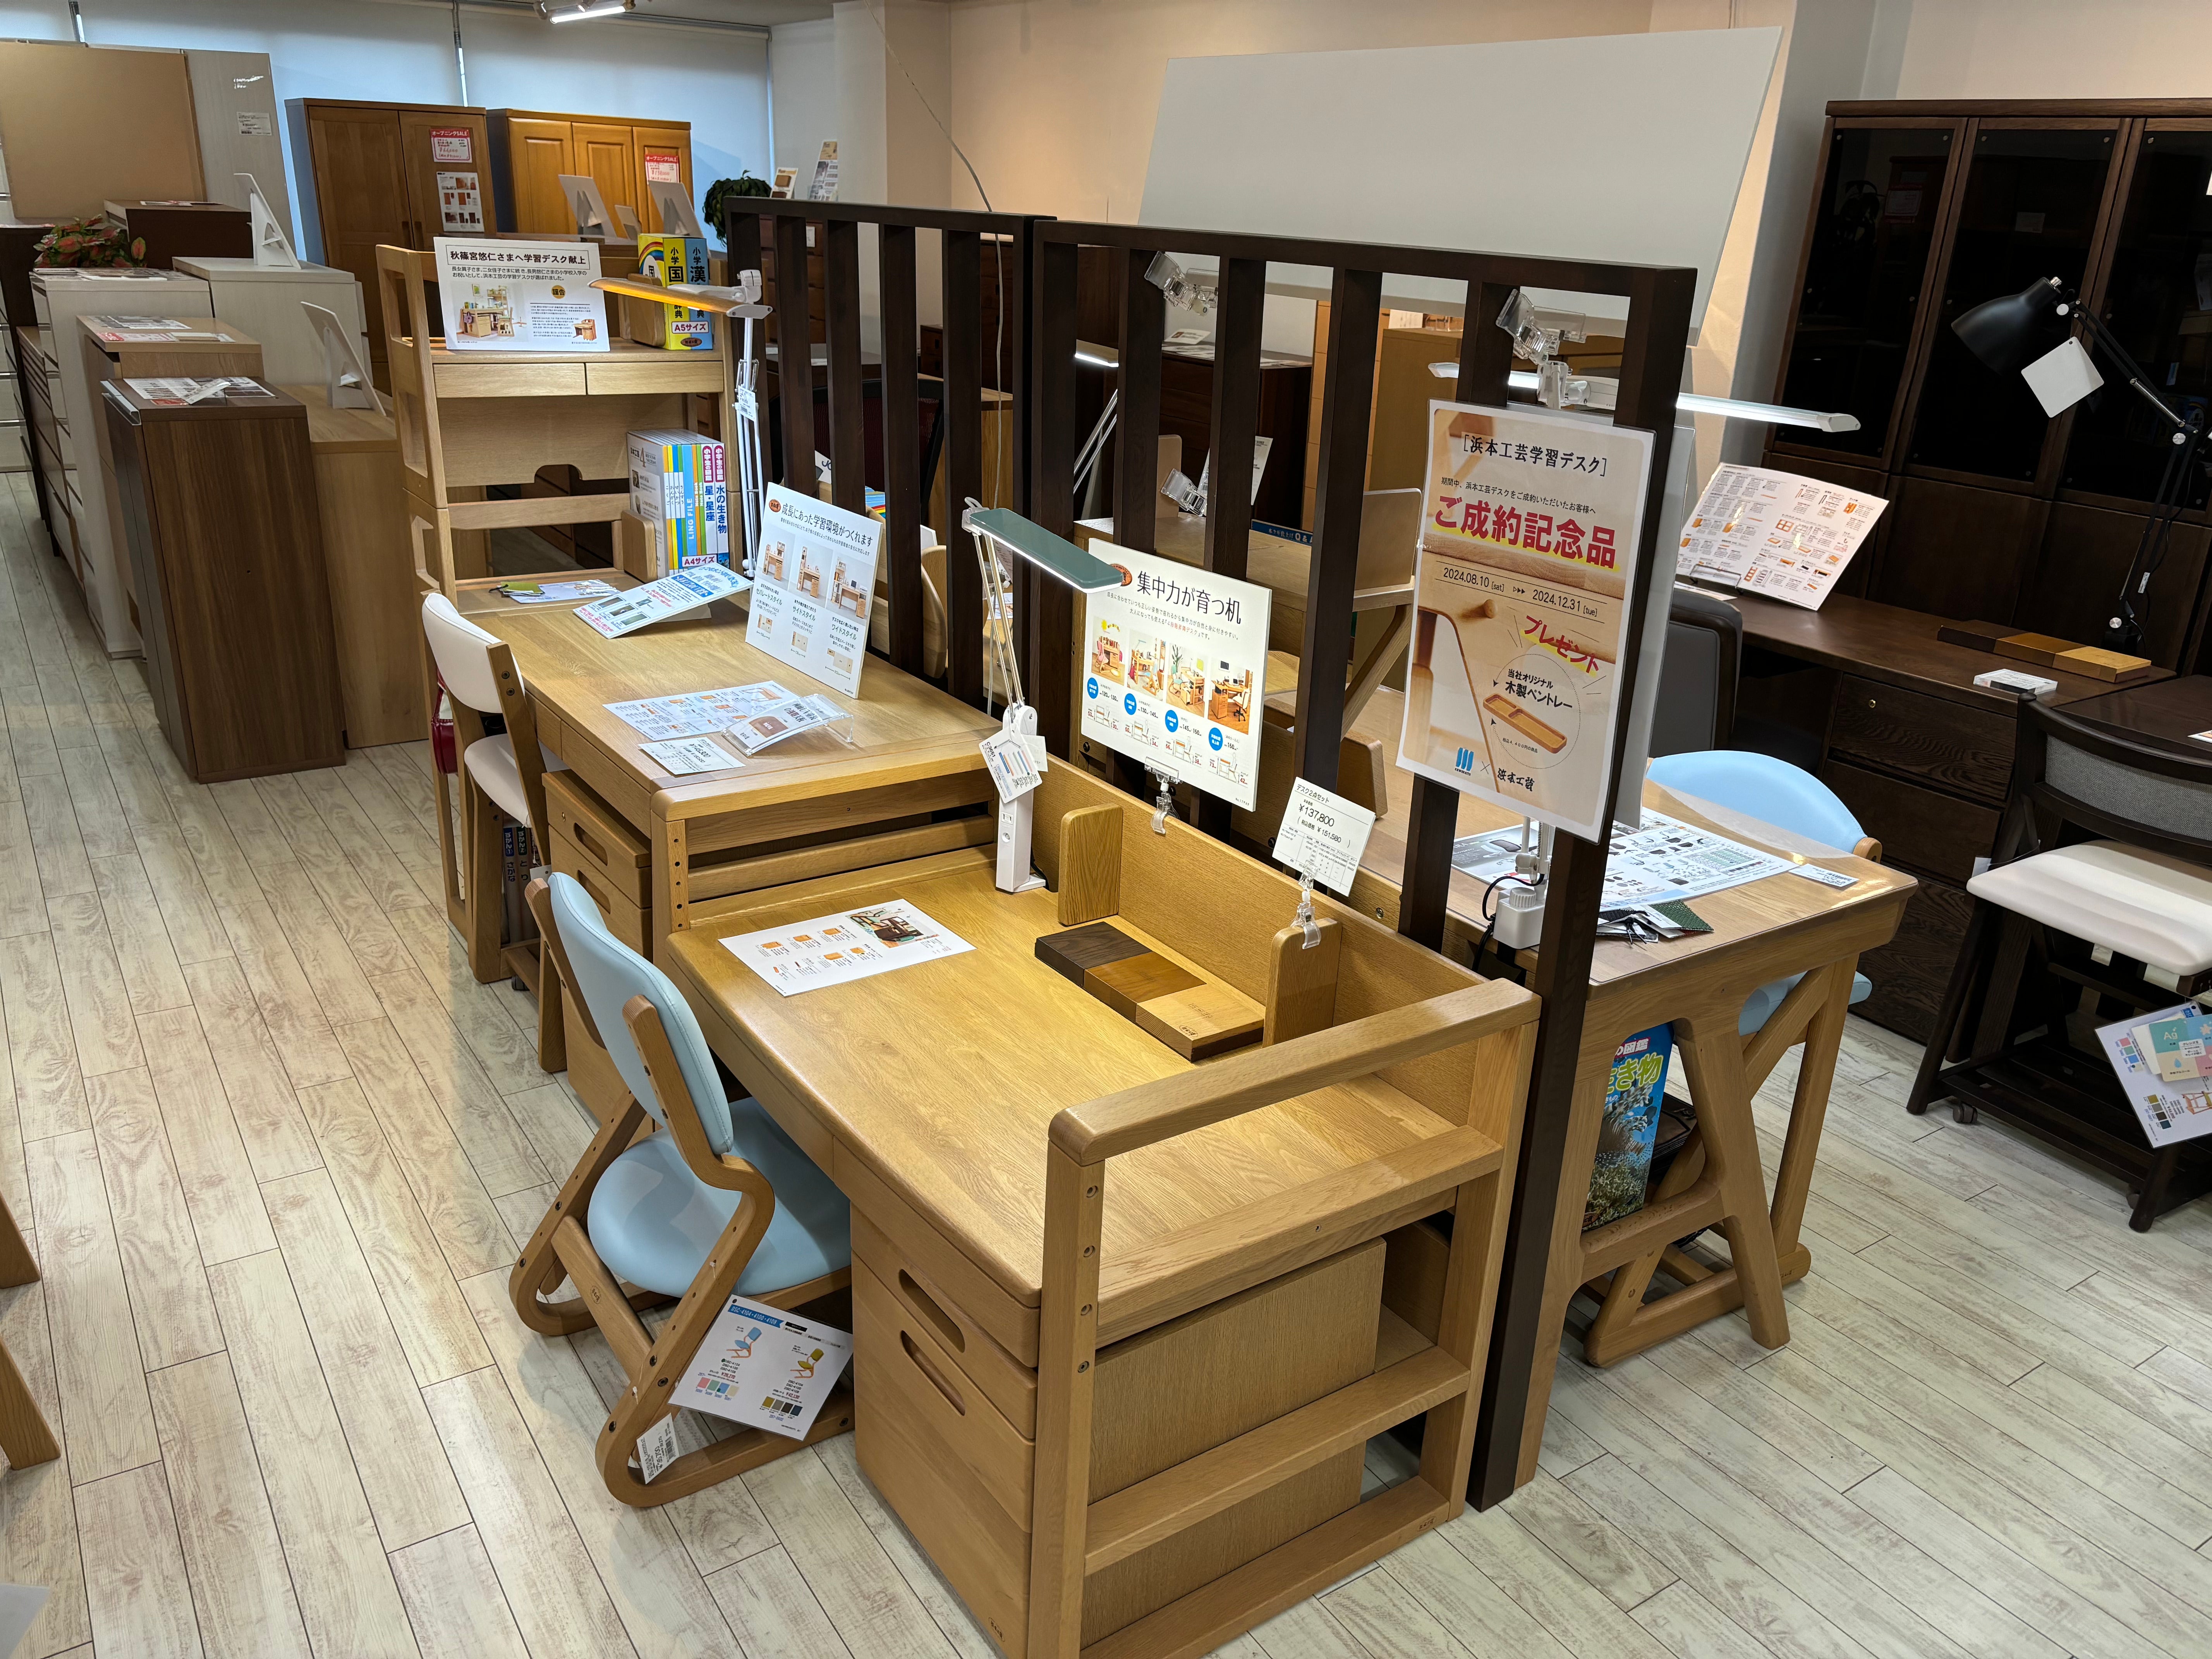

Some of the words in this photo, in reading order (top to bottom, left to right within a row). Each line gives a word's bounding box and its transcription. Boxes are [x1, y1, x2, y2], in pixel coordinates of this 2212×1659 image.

[450, 251, 586, 264] 秋篠宮悠仁さまへ学習デスク献上
[674, 323, 706, 331] A5サイズ
[703, 448, 713, 481] 小学生の
[715, 448, 724, 481] 小学生の
[705, 486, 715, 521] 星・星座
[716, 485, 726, 534] 水の生き物
[1441, 477, 1596, 514] 期間中、浜本工芸デスクをご成約いただいたお客様へ
[781, 502, 873, 549] 成長にあった学習環境がつくれます
[1435, 496, 1616, 568] ご成約記念品
[684, 556, 715, 565] A4サイズ
[1137, 570, 1242, 625] 集中力が育つ机
[1444, 568, 1489, 587] 2024.08.10
[1491, 581, 1504, 592] [sat]
[1533, 589, 1580, 612] 2024.12.31
[1583, 605, 1597, 617] [tue]
[793, 605, 816, 622] サイドスタイル
[831, 623, 857, 641] ワイドスタイル
[1524, 615, 1599, 674] プレゼント
[1508, 669, 1553, 689] 当社オリジナル
[1505, 681, 1573, 709] 木製ペントレー
[1296, 784, 1330, 804] デスク2点セット
[1298, 803, 1335, 828] ¥137,800
[507, 862, 515, 882] さかな
[520, 860, 528, 881] とり
